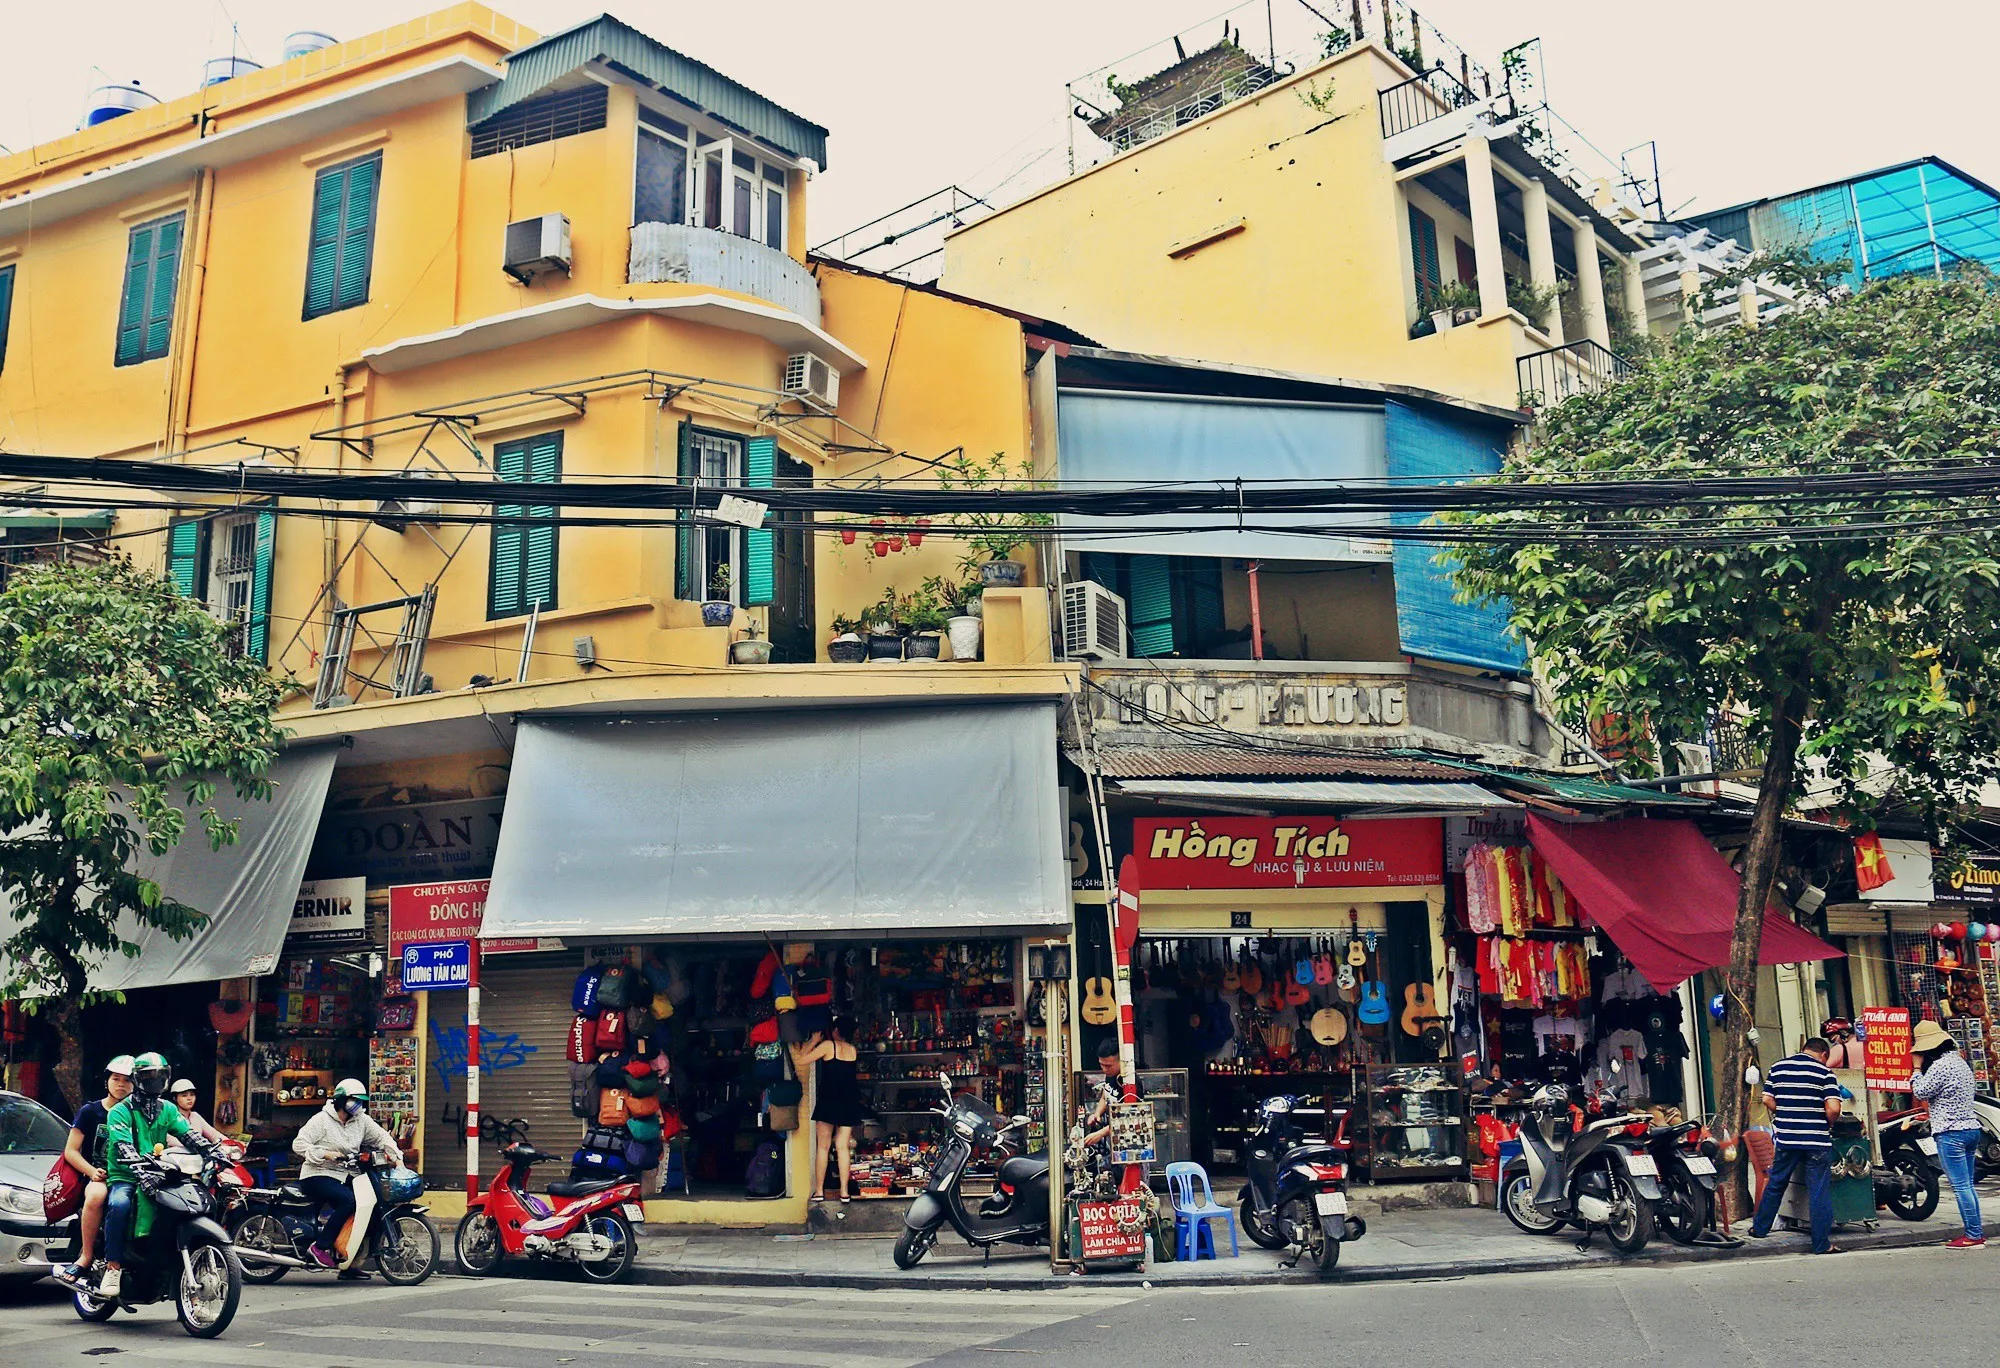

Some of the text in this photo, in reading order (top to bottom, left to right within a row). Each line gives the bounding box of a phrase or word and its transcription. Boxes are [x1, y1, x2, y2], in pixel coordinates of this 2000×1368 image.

[1149, 820, 1351, 867] Hồng Tích
[1253, 862, 1289, 875] NHẠC
[1313, 863, 1322, 873] &
[1326, 861, 1351, 873] LƯU
[1354, 861, 1385, 875] NIỆM
[413, 884, 455, 897] CHUYÊN
[429, 897, 469, 921] ĐỒNG
[1235, 914, 1248, 925] 24
[433, 947, 454, 960] PHỐ
[406, 963, 468, 983] LƯƠNG VĂN CAN
[573, 1016, 587, 1063] Supreme
[1868, 1037, 1892, 1055] CHÌA
[1082, 1206, 1107, 1224] BỌC
[1085, 1237, 1104, 1248] LÀM
[1105, 1235, 1126, 1246] CHÌA
